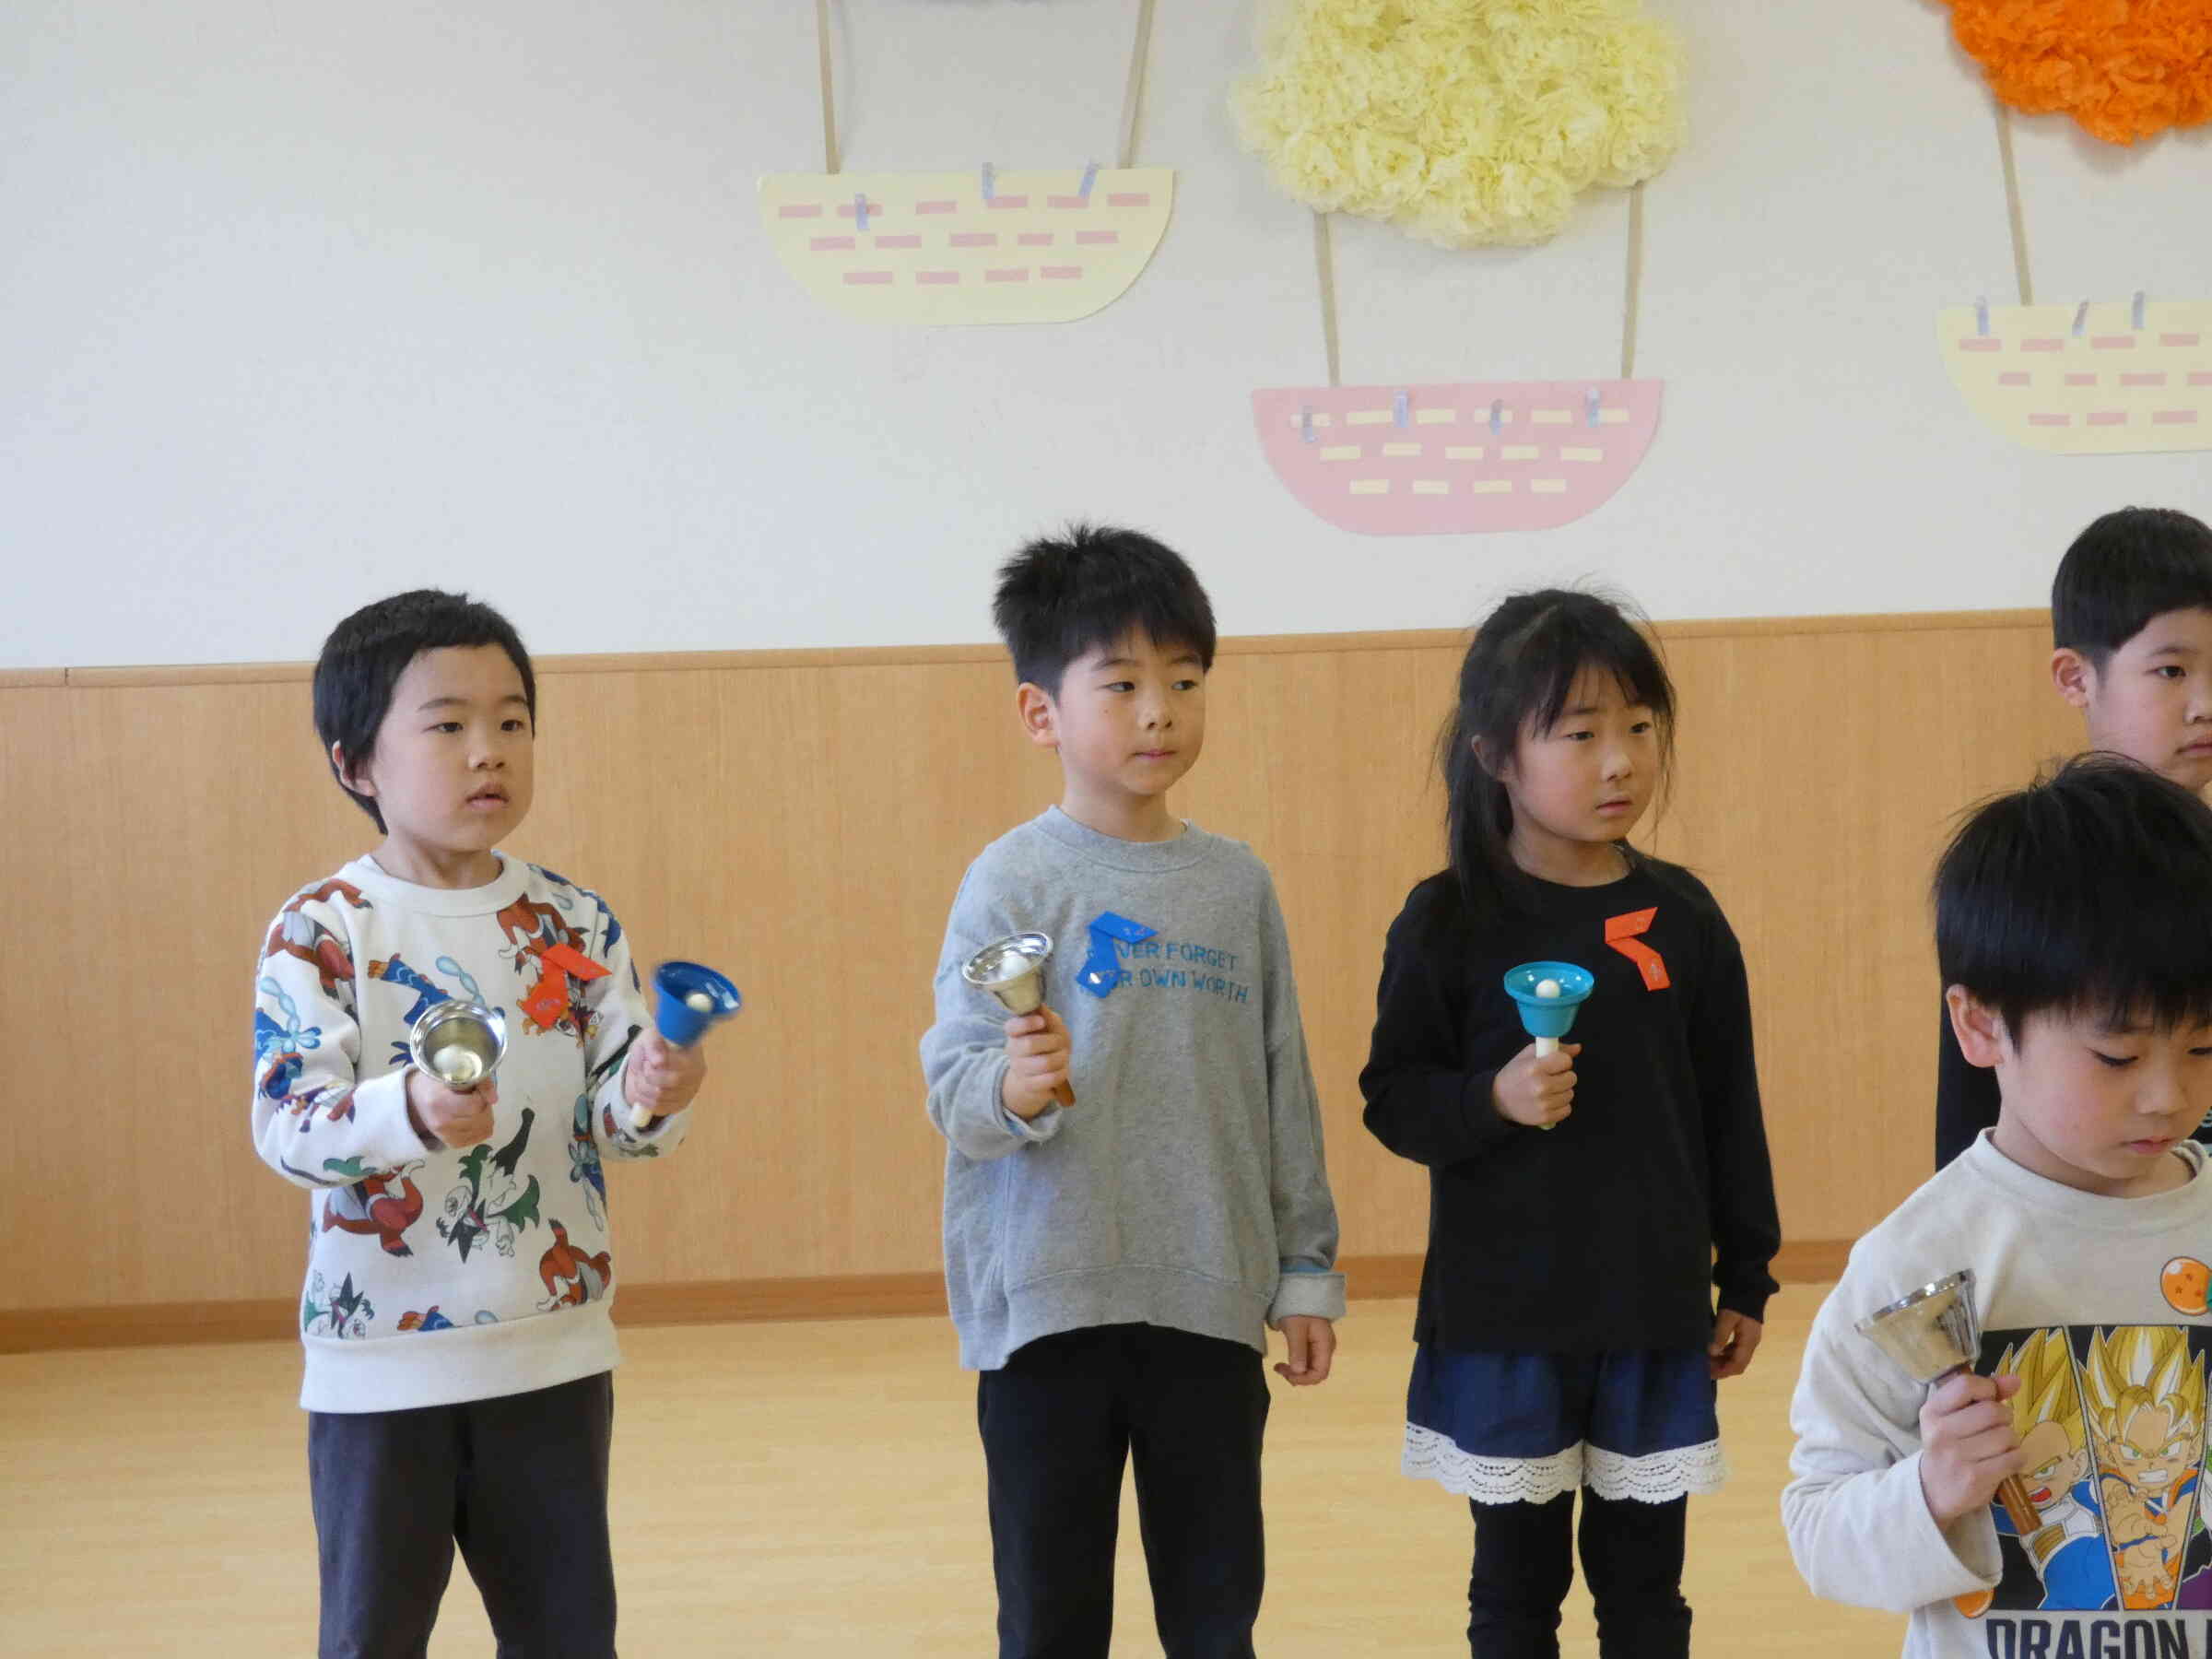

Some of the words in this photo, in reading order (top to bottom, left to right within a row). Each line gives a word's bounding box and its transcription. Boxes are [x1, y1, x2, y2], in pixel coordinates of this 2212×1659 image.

[1115, 941, 1159, 959] VER
[1166, 942, 1239, 971] FORGET
[1140, 968, 1186, 988] OWN
[1192, 971, 1249, 1003] WORTH
[1986, 1618, 2189, 1659] DRAGON
